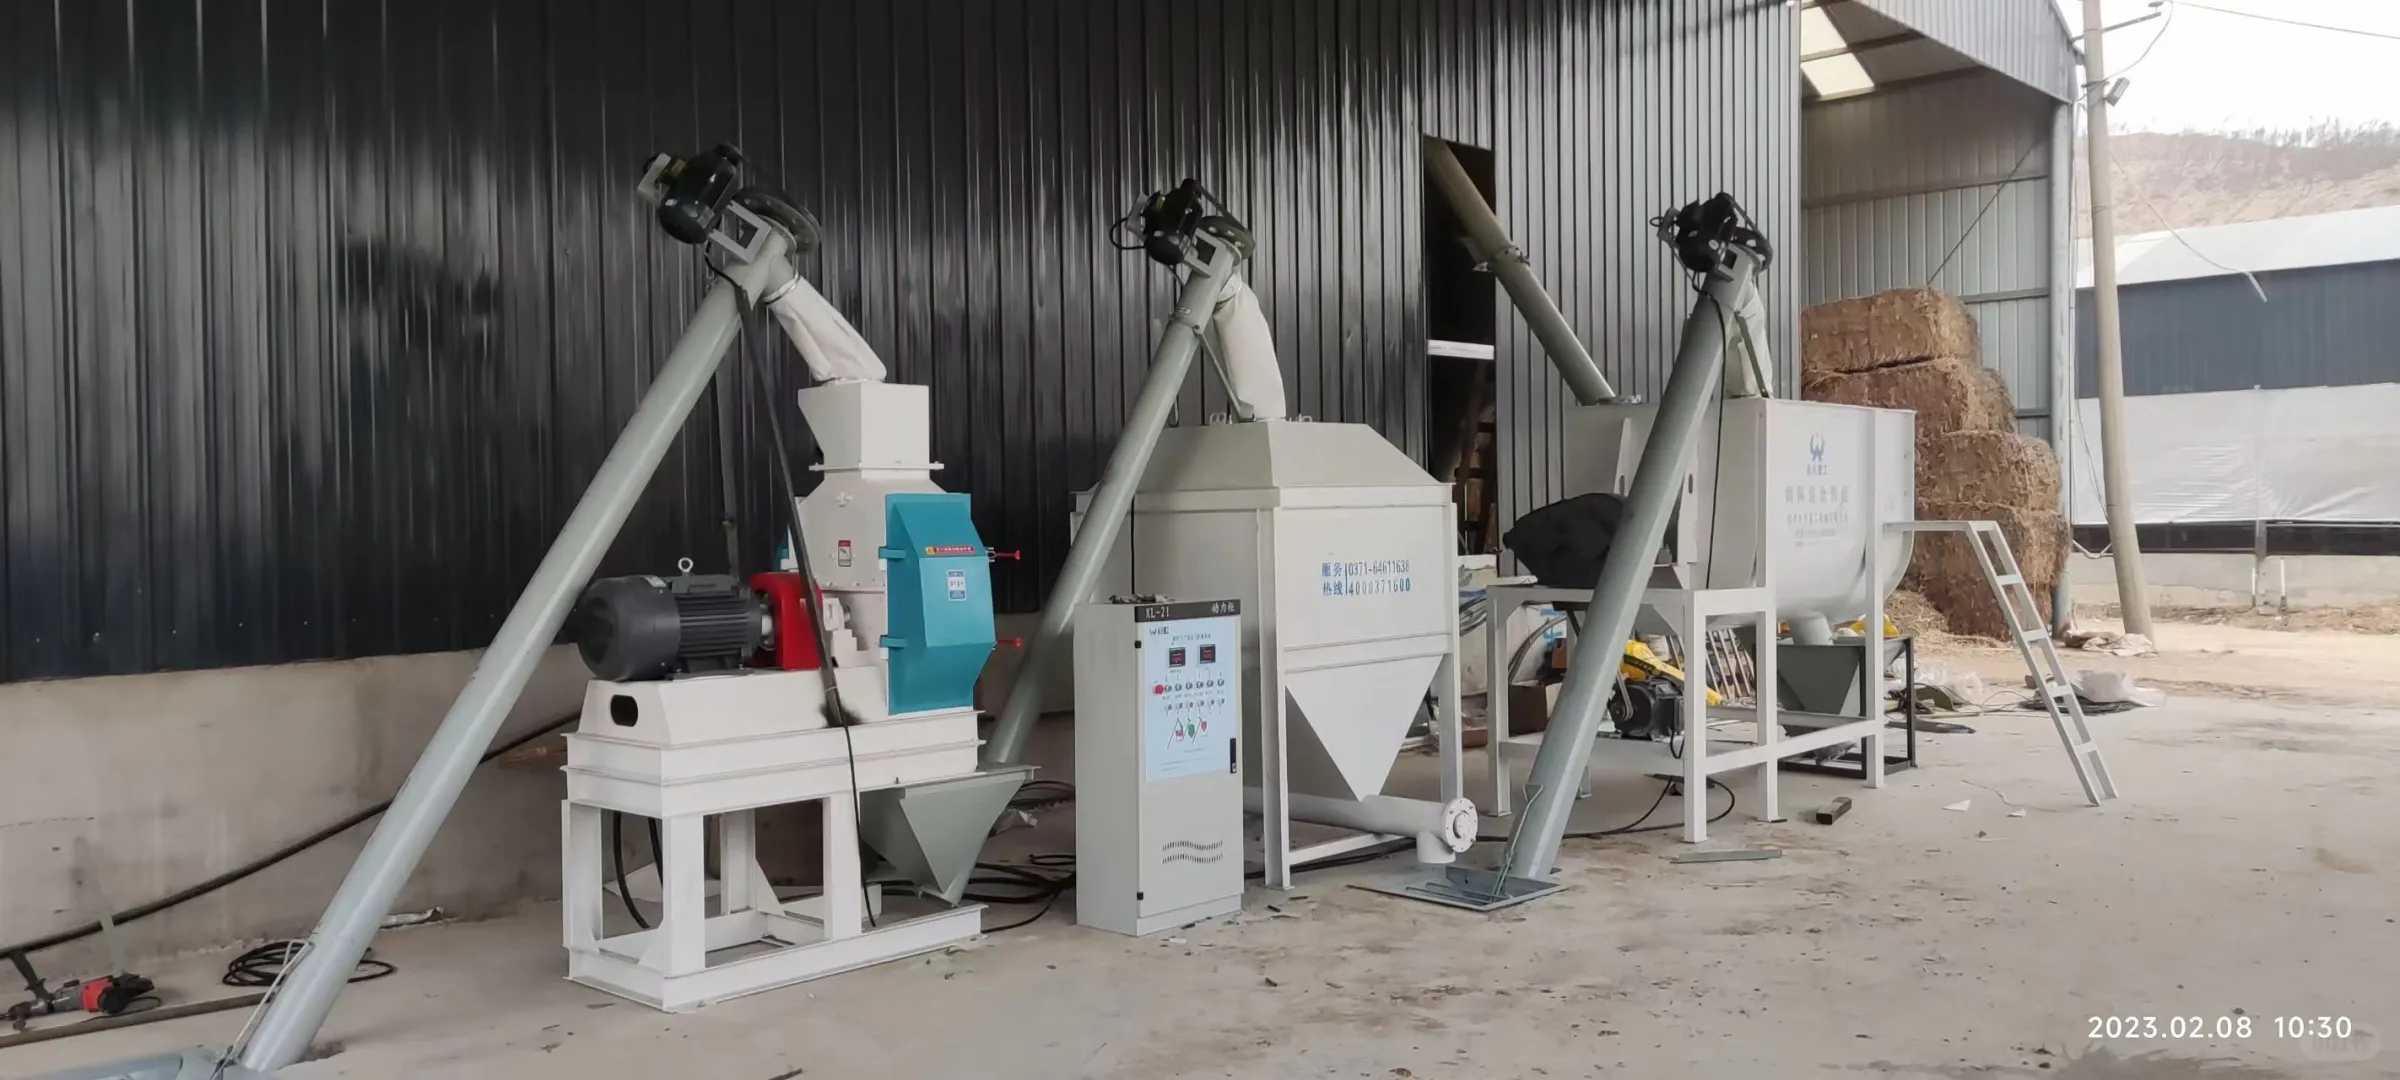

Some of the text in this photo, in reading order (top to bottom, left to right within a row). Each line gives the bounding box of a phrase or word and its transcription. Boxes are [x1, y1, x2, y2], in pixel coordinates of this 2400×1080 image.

[1322, 561, 1342, 577] 服务
[1322, 580, 1343, 596] 热线
[1145, 606, 1170, 618] XL-21
[1211, 601, 1236, 614] 动力柜
